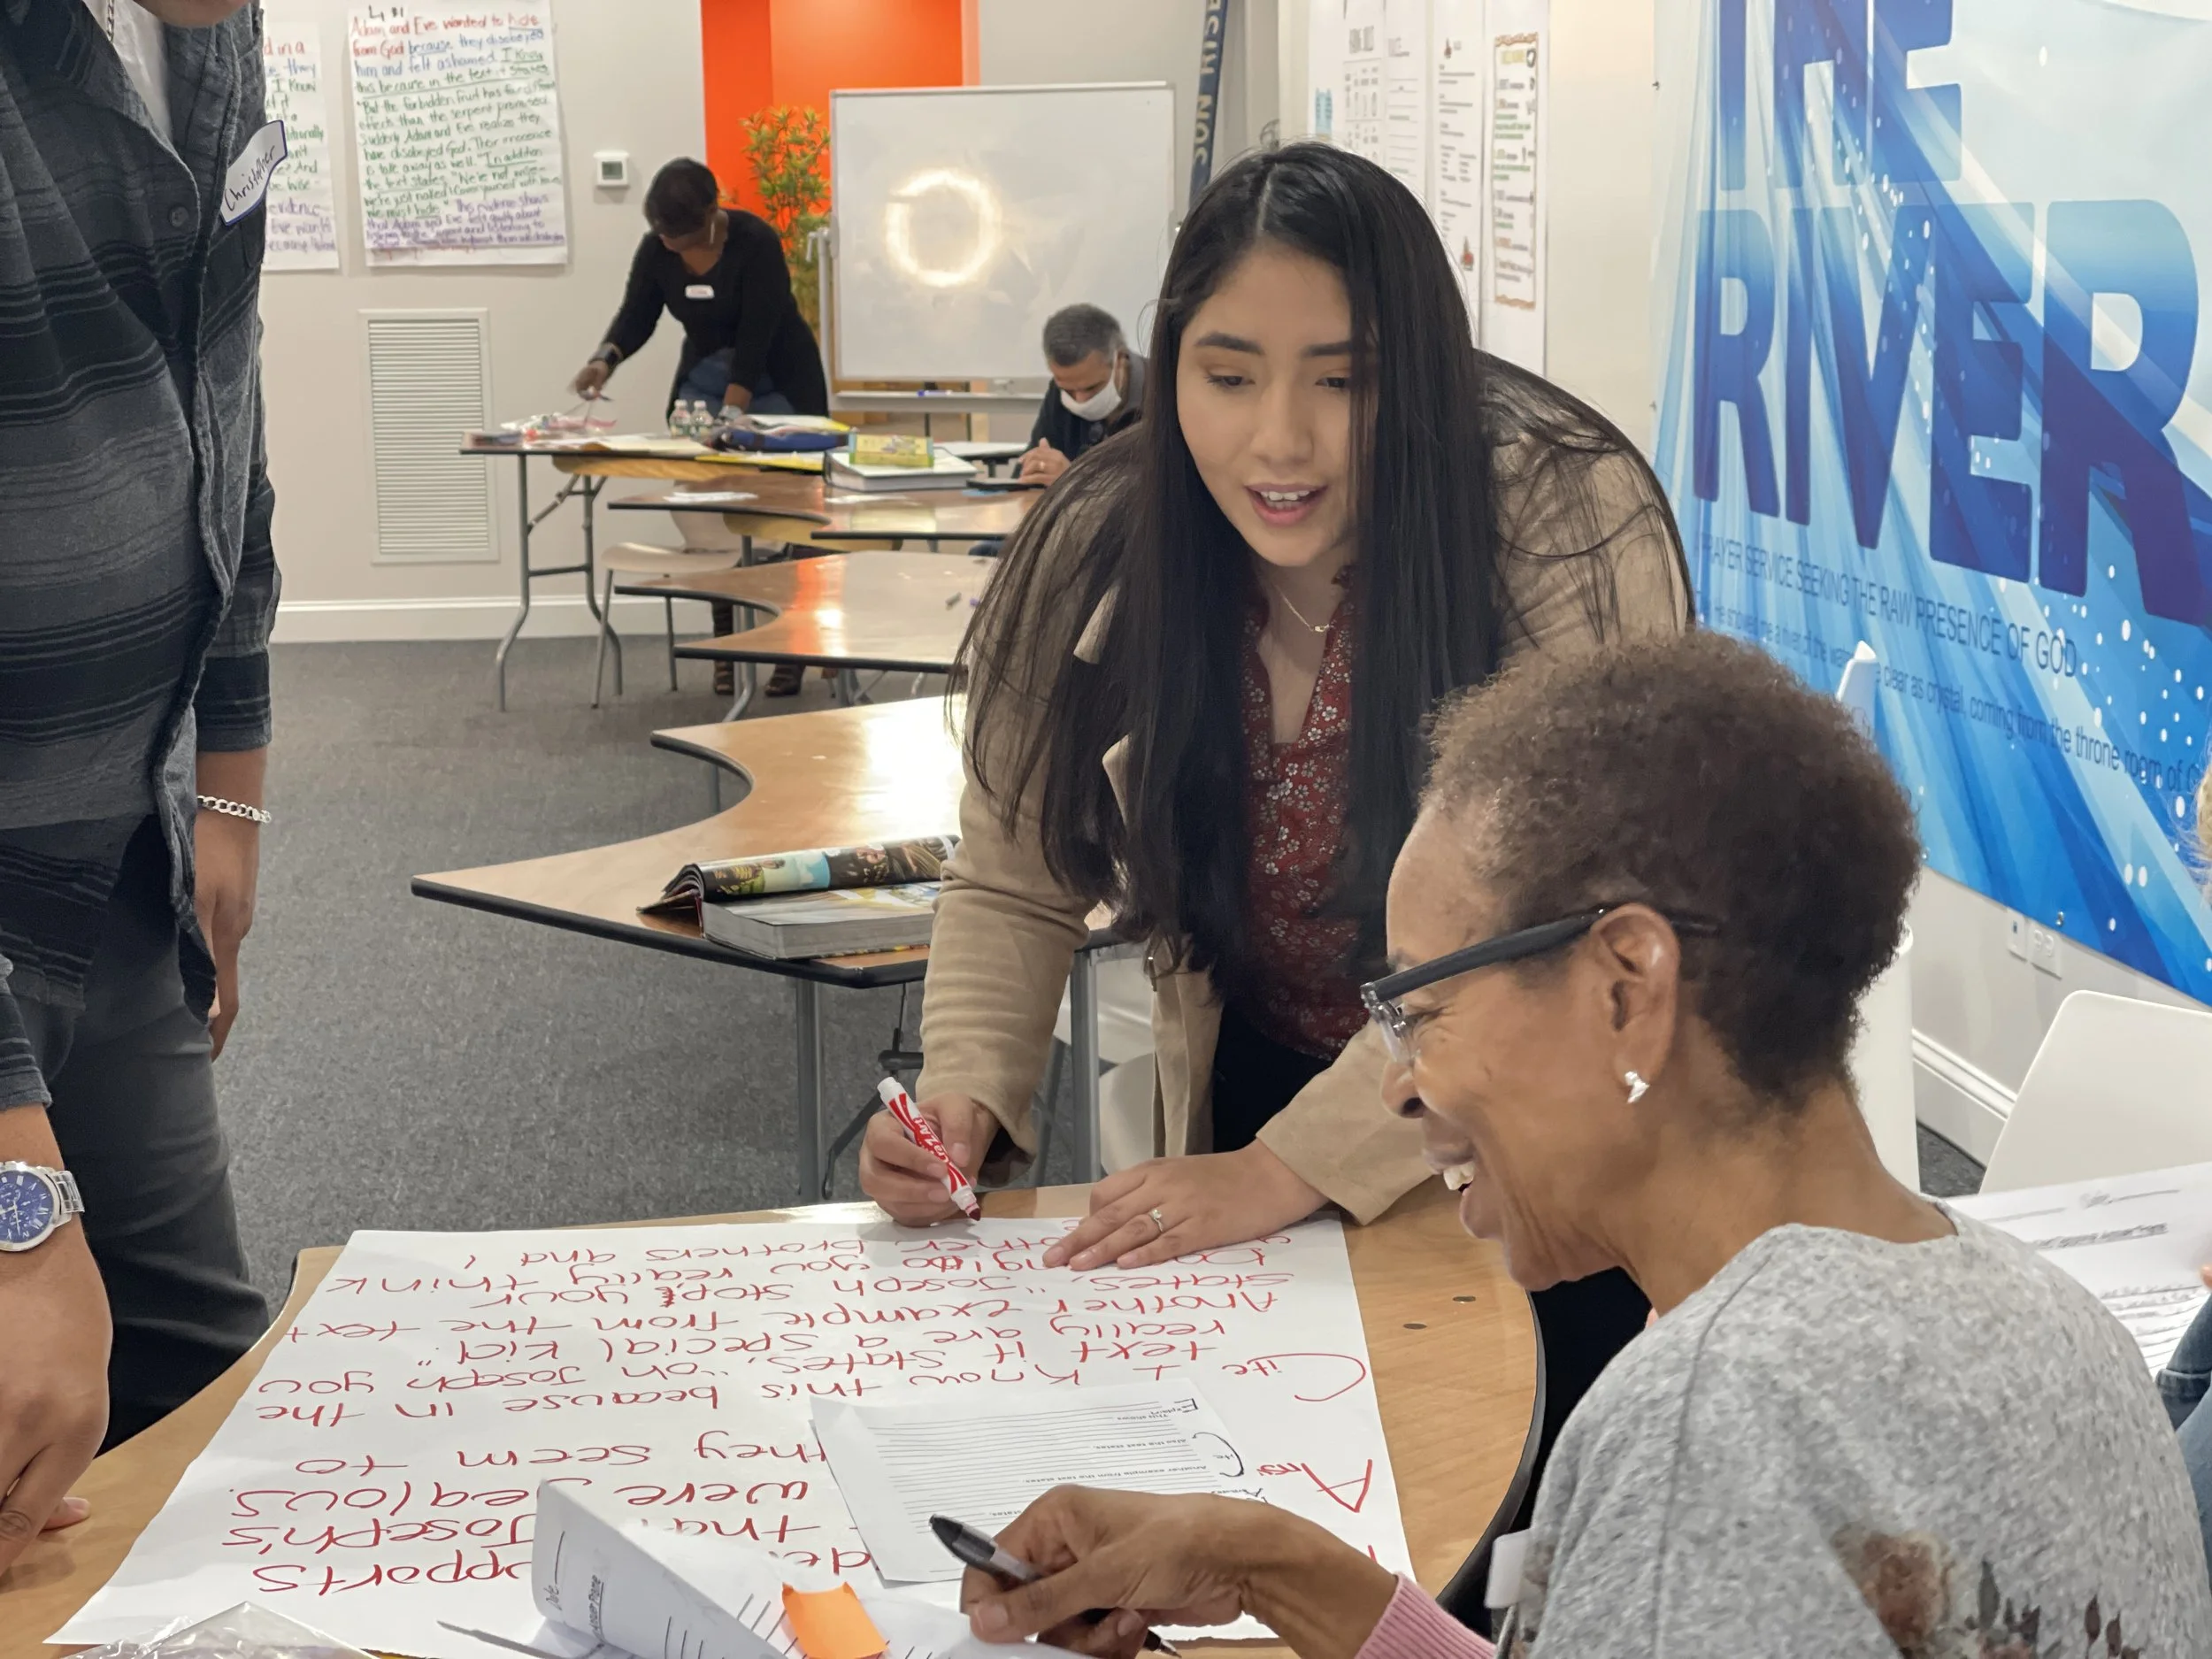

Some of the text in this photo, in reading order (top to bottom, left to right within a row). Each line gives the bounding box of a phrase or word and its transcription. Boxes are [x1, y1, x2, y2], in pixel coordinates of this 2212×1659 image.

[389, 24, 410, 35] and
[414, 16, 437, 35] Eve
[442, 14, 487, 29] wanted
[492, 14, 503, 25] to
[380, 40, 404, 59] God
[408, 40, 451, 55] because
[459, 34, 483, 49] they
[355, 60, 378, 77] him
[382, 63, 402, 76] and
[408, 55, 430, 73] felt
[445, 72, 465, 83] the
[469, 65, 491, 79] text
[430, 111, 448, 122] the
[518, 111, 541, 126] they
[1694, 199, 2212, 627] RIVER
[1746, 544, 1793, 588] SERVICE
[1796, 559, 1849, 607] SEEKING
[1853, 577, 1876, 616] THE
[1880, 586, 1913, 627] RAW
[1916, 596, 2001, 656] PRESENCE
[2007, 623, 2031, 661] OF
[2036, 631, 2077, 678] GOD
[1970, 695, 2014, 740] coming
[2016, 705, 2047, 743] from
[2051, 718, 2071, 754] the
[2076, 726, 2120, 771] throne
[2124, 750, 2162, 785] room
[519, 1248, 617, 1266] and
[647, 1238, 864, 1261] brothers
[568, 1262, 733, 1288] really
[770, 1253, 871, 1275] you
[326, 1274, 538, 1297] think
[469, 1288, 628, 1309] your
[287, 1293, 1279, 1341] Another example from the text
[1048, 1316, 1225, 1337] really
[856, 1333, 887, 1348] a
[922, 1327, 1021, 1339] are
[983, 1341, 1025, 1364] it
[1071, 1340, 1217, 1362] text
[258, 1371, 375, 1394] you
[406, 1365, 587, 1392] Joseph
[762, 1380, 882, 1398] this
[503, 1383, 718, 1411] because
[257, 1405, 365, 1427] the
[394, 1404, 454, 1418] in
[295, 1430, 826, 1475] they seem to
[618, 1480, 808, 1505] were
